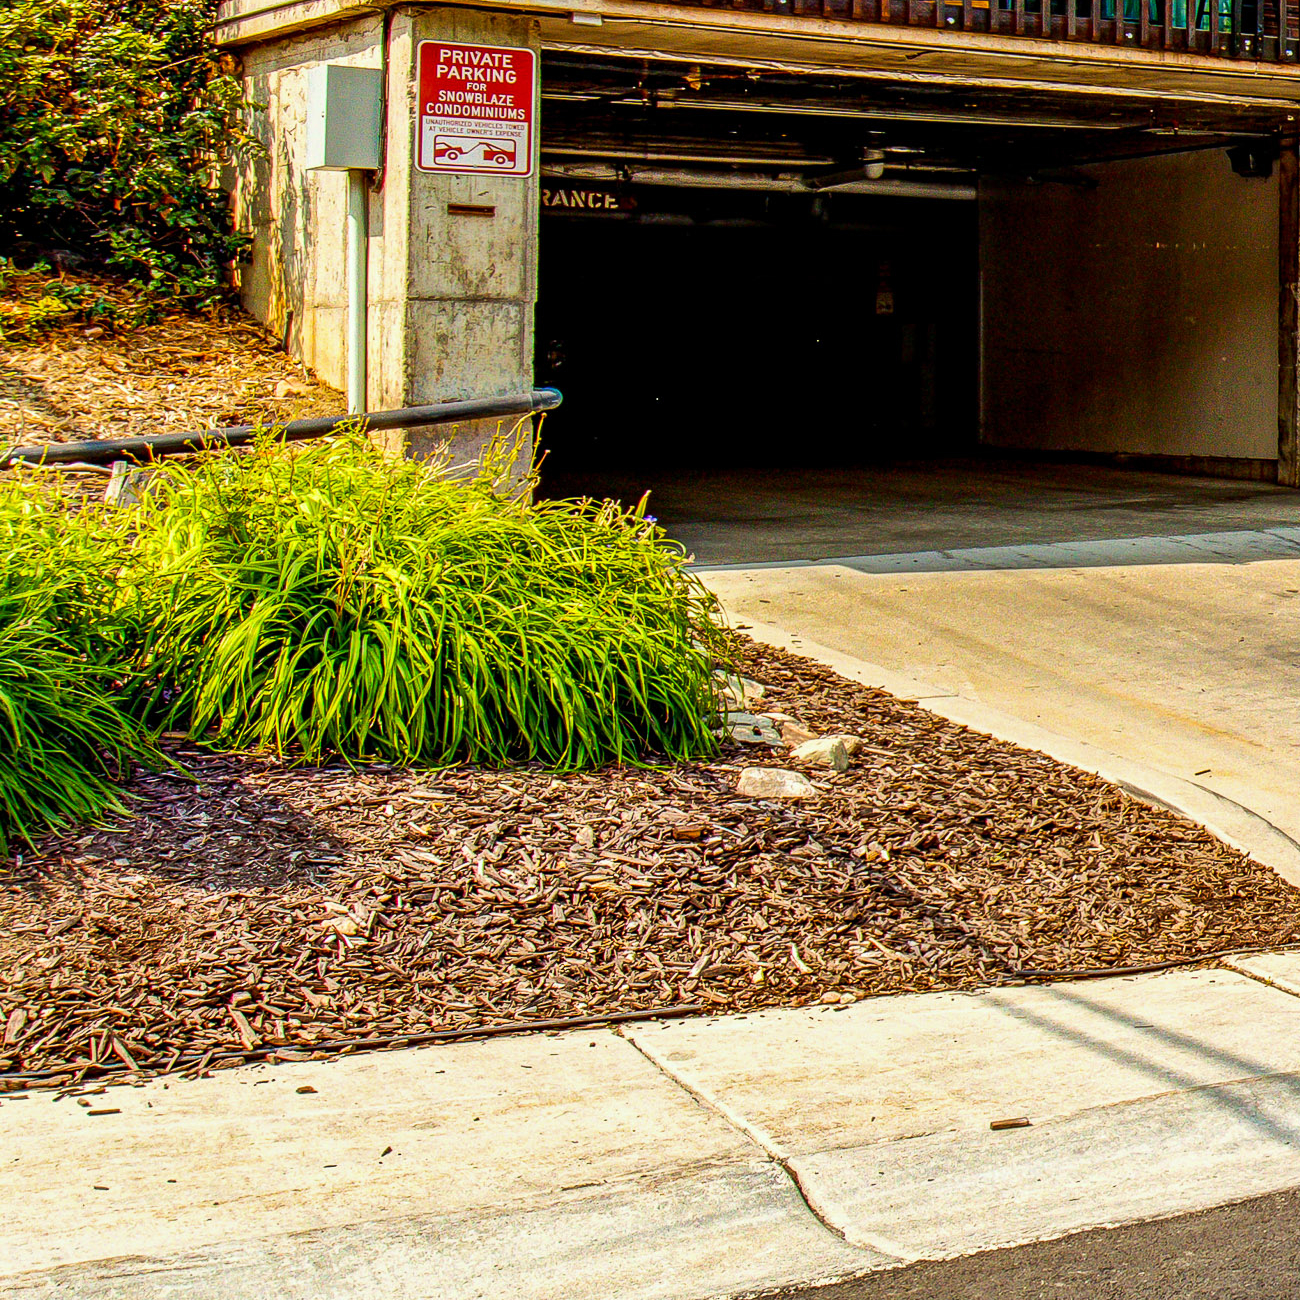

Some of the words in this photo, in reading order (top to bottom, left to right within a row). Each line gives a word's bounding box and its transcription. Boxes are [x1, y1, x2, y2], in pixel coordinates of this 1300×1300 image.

[439, 49, 513, 68] PRIVATE
[436, 64, 517, 84] PARKING
[466, 82, 487, 91] FOR
[438, 90, 514, 107] SNOWBLAZE
[426, 102, 525, 120] CONDOMINIUMS
[425, 118, 472, 127] UNAUTHORIZED
[474, 121, 503, 130] VEHICLES
[439, 126, 464, 134] VEHICLE
